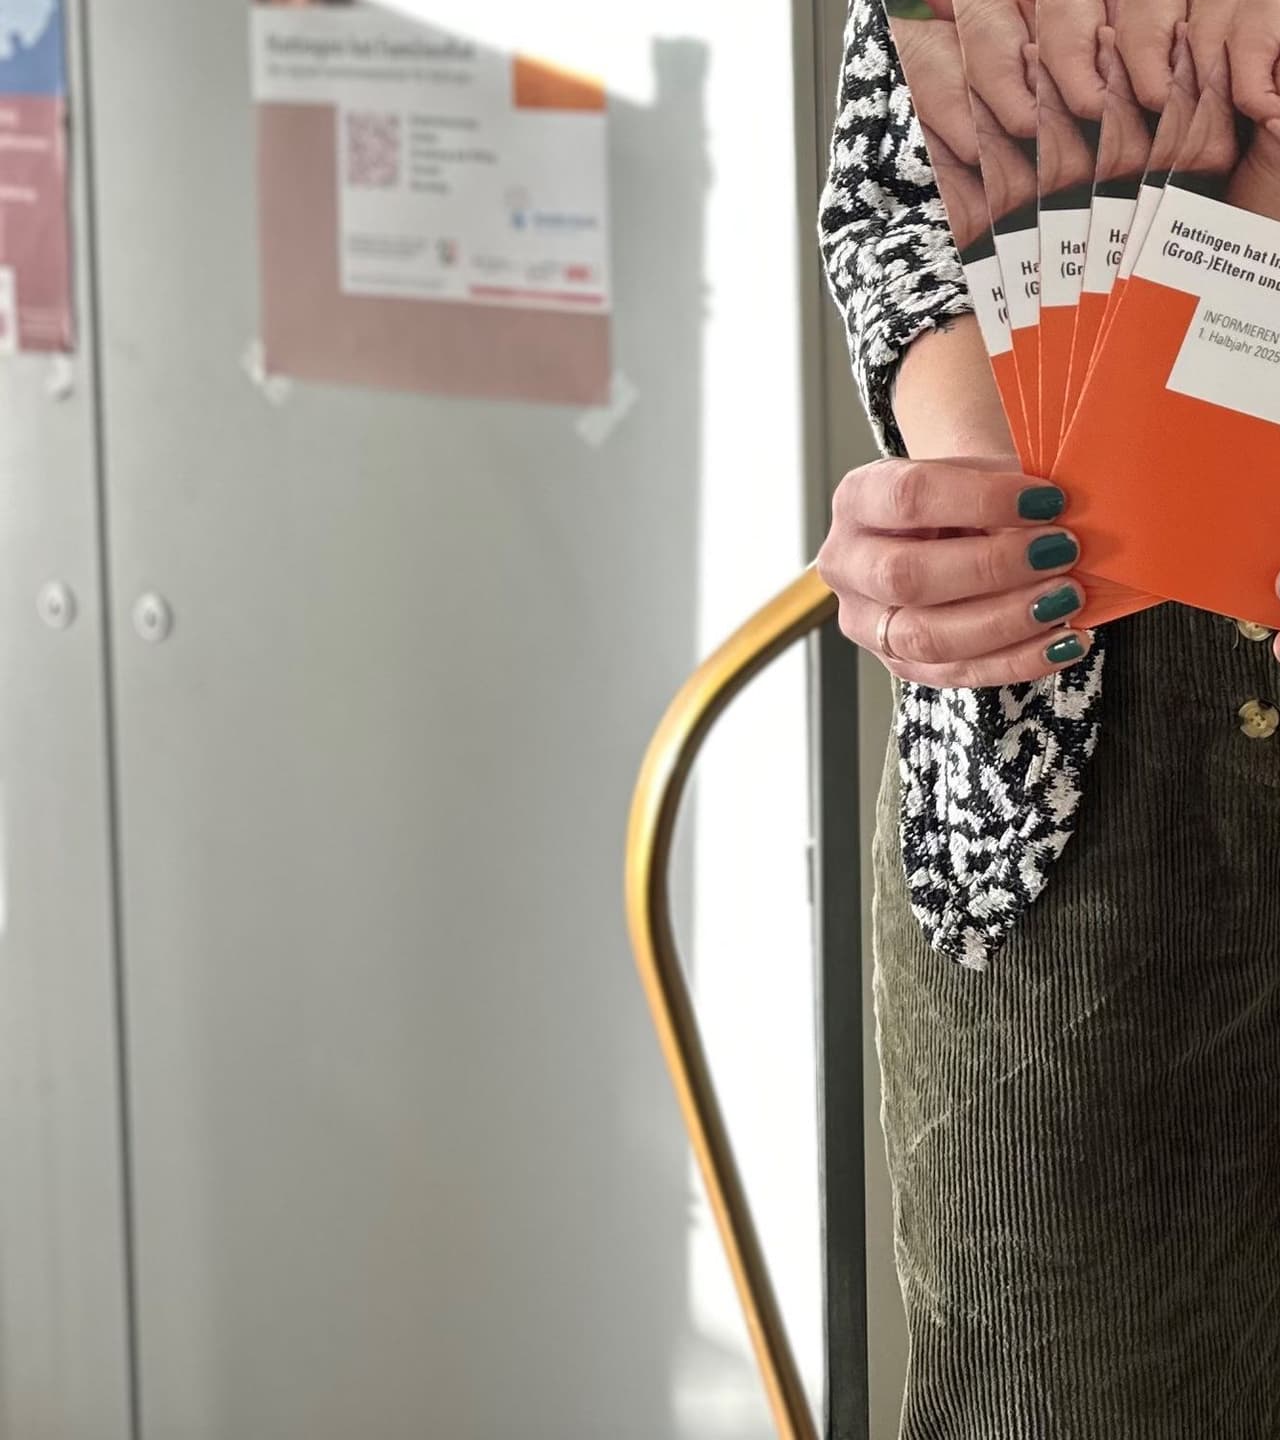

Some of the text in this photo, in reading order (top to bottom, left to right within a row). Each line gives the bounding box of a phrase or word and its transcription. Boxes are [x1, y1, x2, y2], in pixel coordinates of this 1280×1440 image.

[1161, 239, 1256, 284] (Groß-)Eltern
[1170, 219, 1242, 256] Hattingen
[1243, 243, 1268, 263] hat
[1198, 327, 1280, 365] 1. Halbjahr 2025
[1203, 309, 1280, 346] INFORMIEREN
